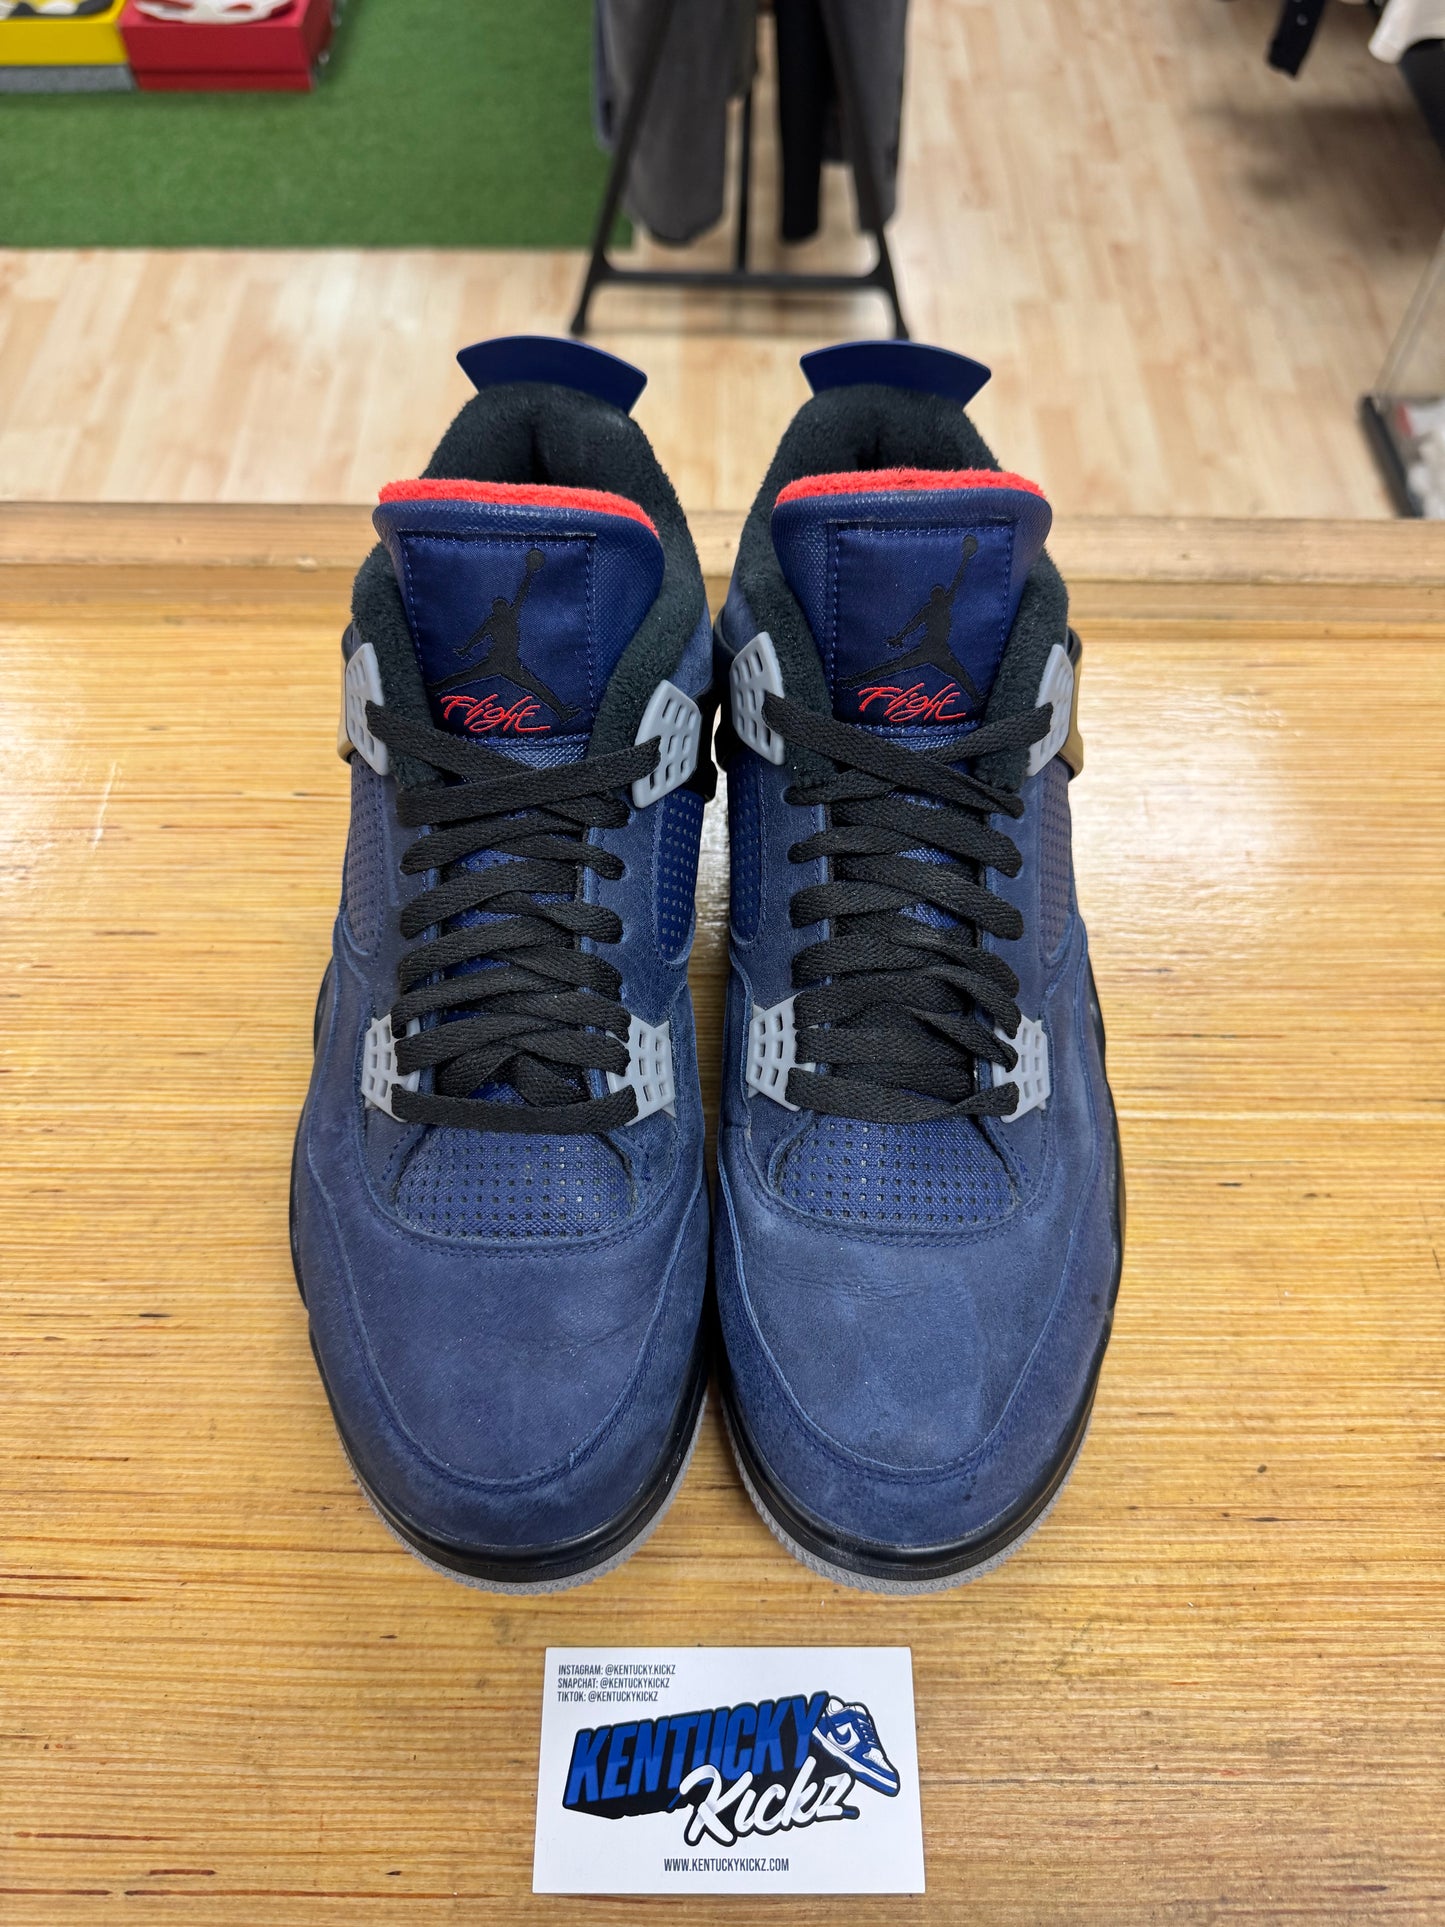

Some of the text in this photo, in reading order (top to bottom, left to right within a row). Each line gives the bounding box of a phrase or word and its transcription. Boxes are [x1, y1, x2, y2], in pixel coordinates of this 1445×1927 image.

[558, 1664, 676, 1676] INSTAGRAM: @KENTUCKY.KICKZ
[557, 1677, 670, 1689] SNAPCHAT: @KENTUCKYKICKZ
[557, 1690, 658, 1702] TIKTOK: @KENTUCKYKICKZ
[563, 1692, 829, 1806] KENTUCKY
[679, 1755, 852, 1843] Kickz
[664, 1858, 789, 1872] WWW.KENTUCKYKICKZ.COM
